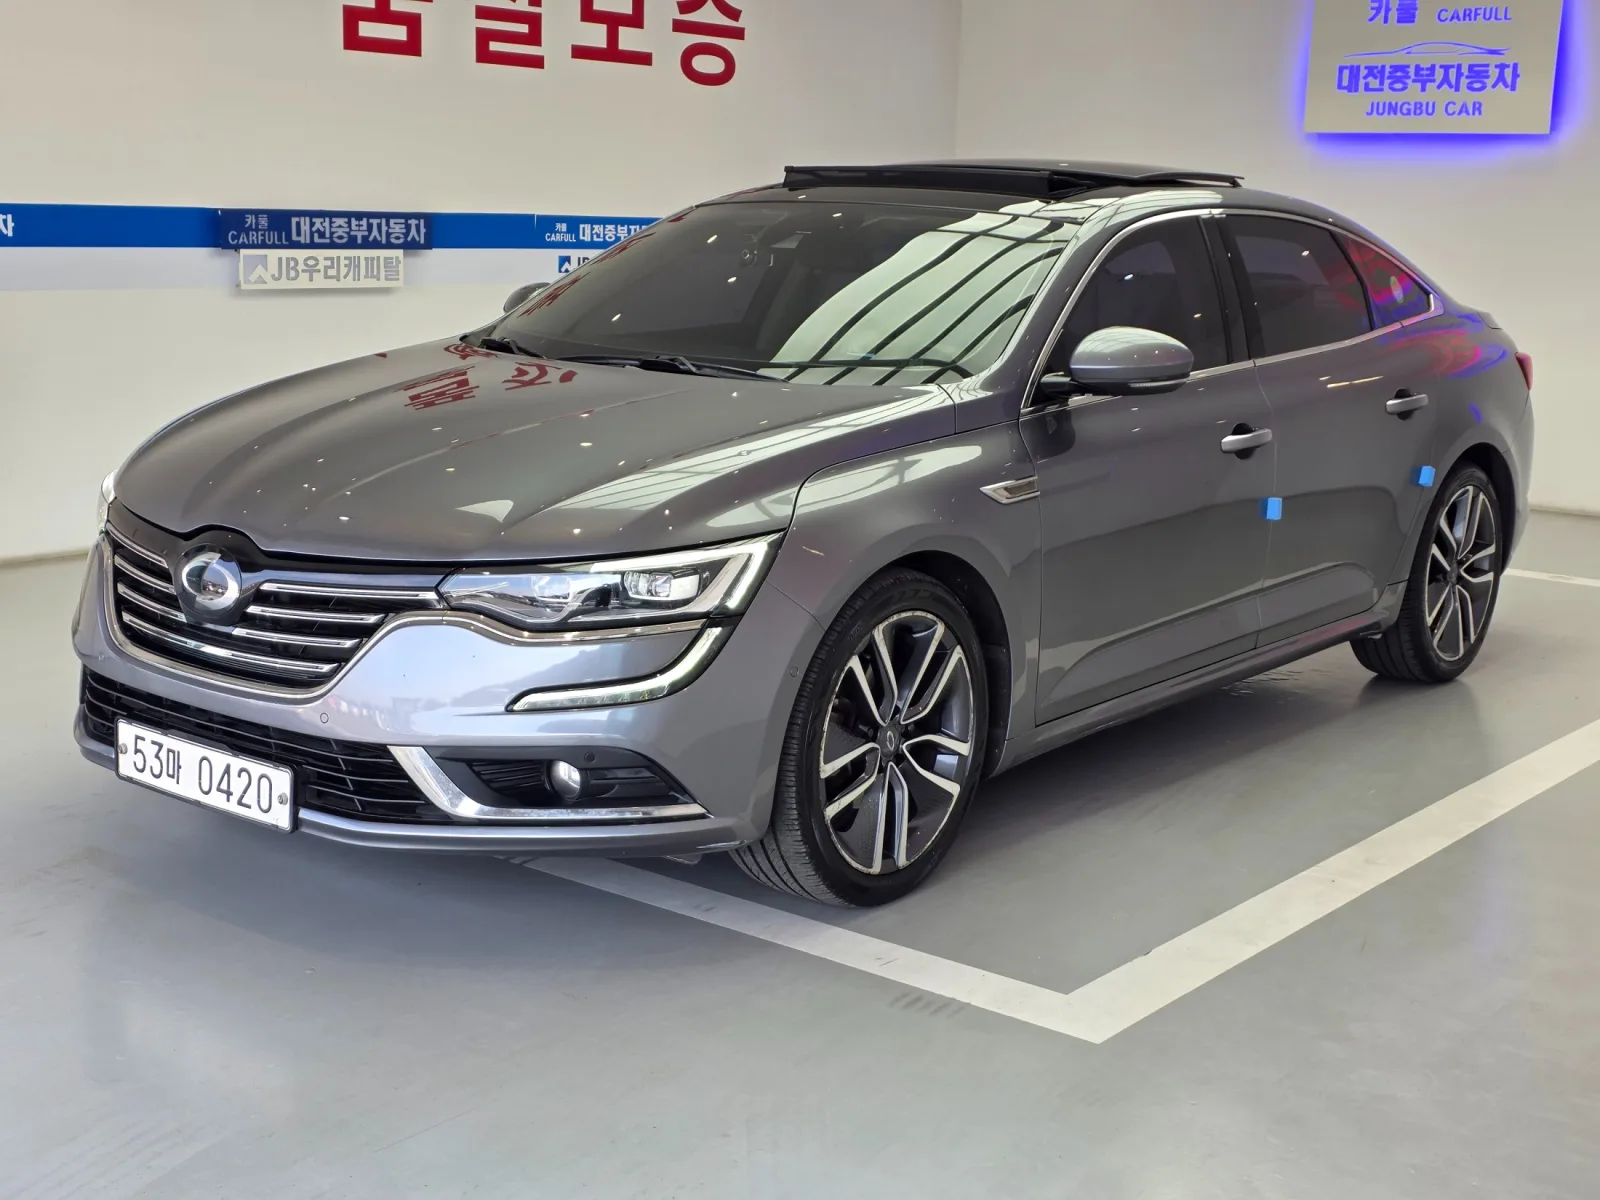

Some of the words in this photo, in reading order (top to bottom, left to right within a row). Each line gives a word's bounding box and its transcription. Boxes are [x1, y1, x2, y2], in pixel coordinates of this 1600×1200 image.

[1437, 7, 1512, 22] CARFULL
[1336, 62, 1521, 93] 대전중부자동차
[1365, 101, 1436, 116] JUNGBU
[1444, 101, 1483, 116] CAR
[244, 214, 269, 230] 카풀
[228, 230, 289, 246] CARFULL
[291, 216, 426, 245] 대전중부자동차
[545, 232, 576, 243] CARFULL
[270, 255, 402, 283] JB우리캐피탈
[133, 734, 182, 785] 53마
[198, 755, 273, 814] 0420
